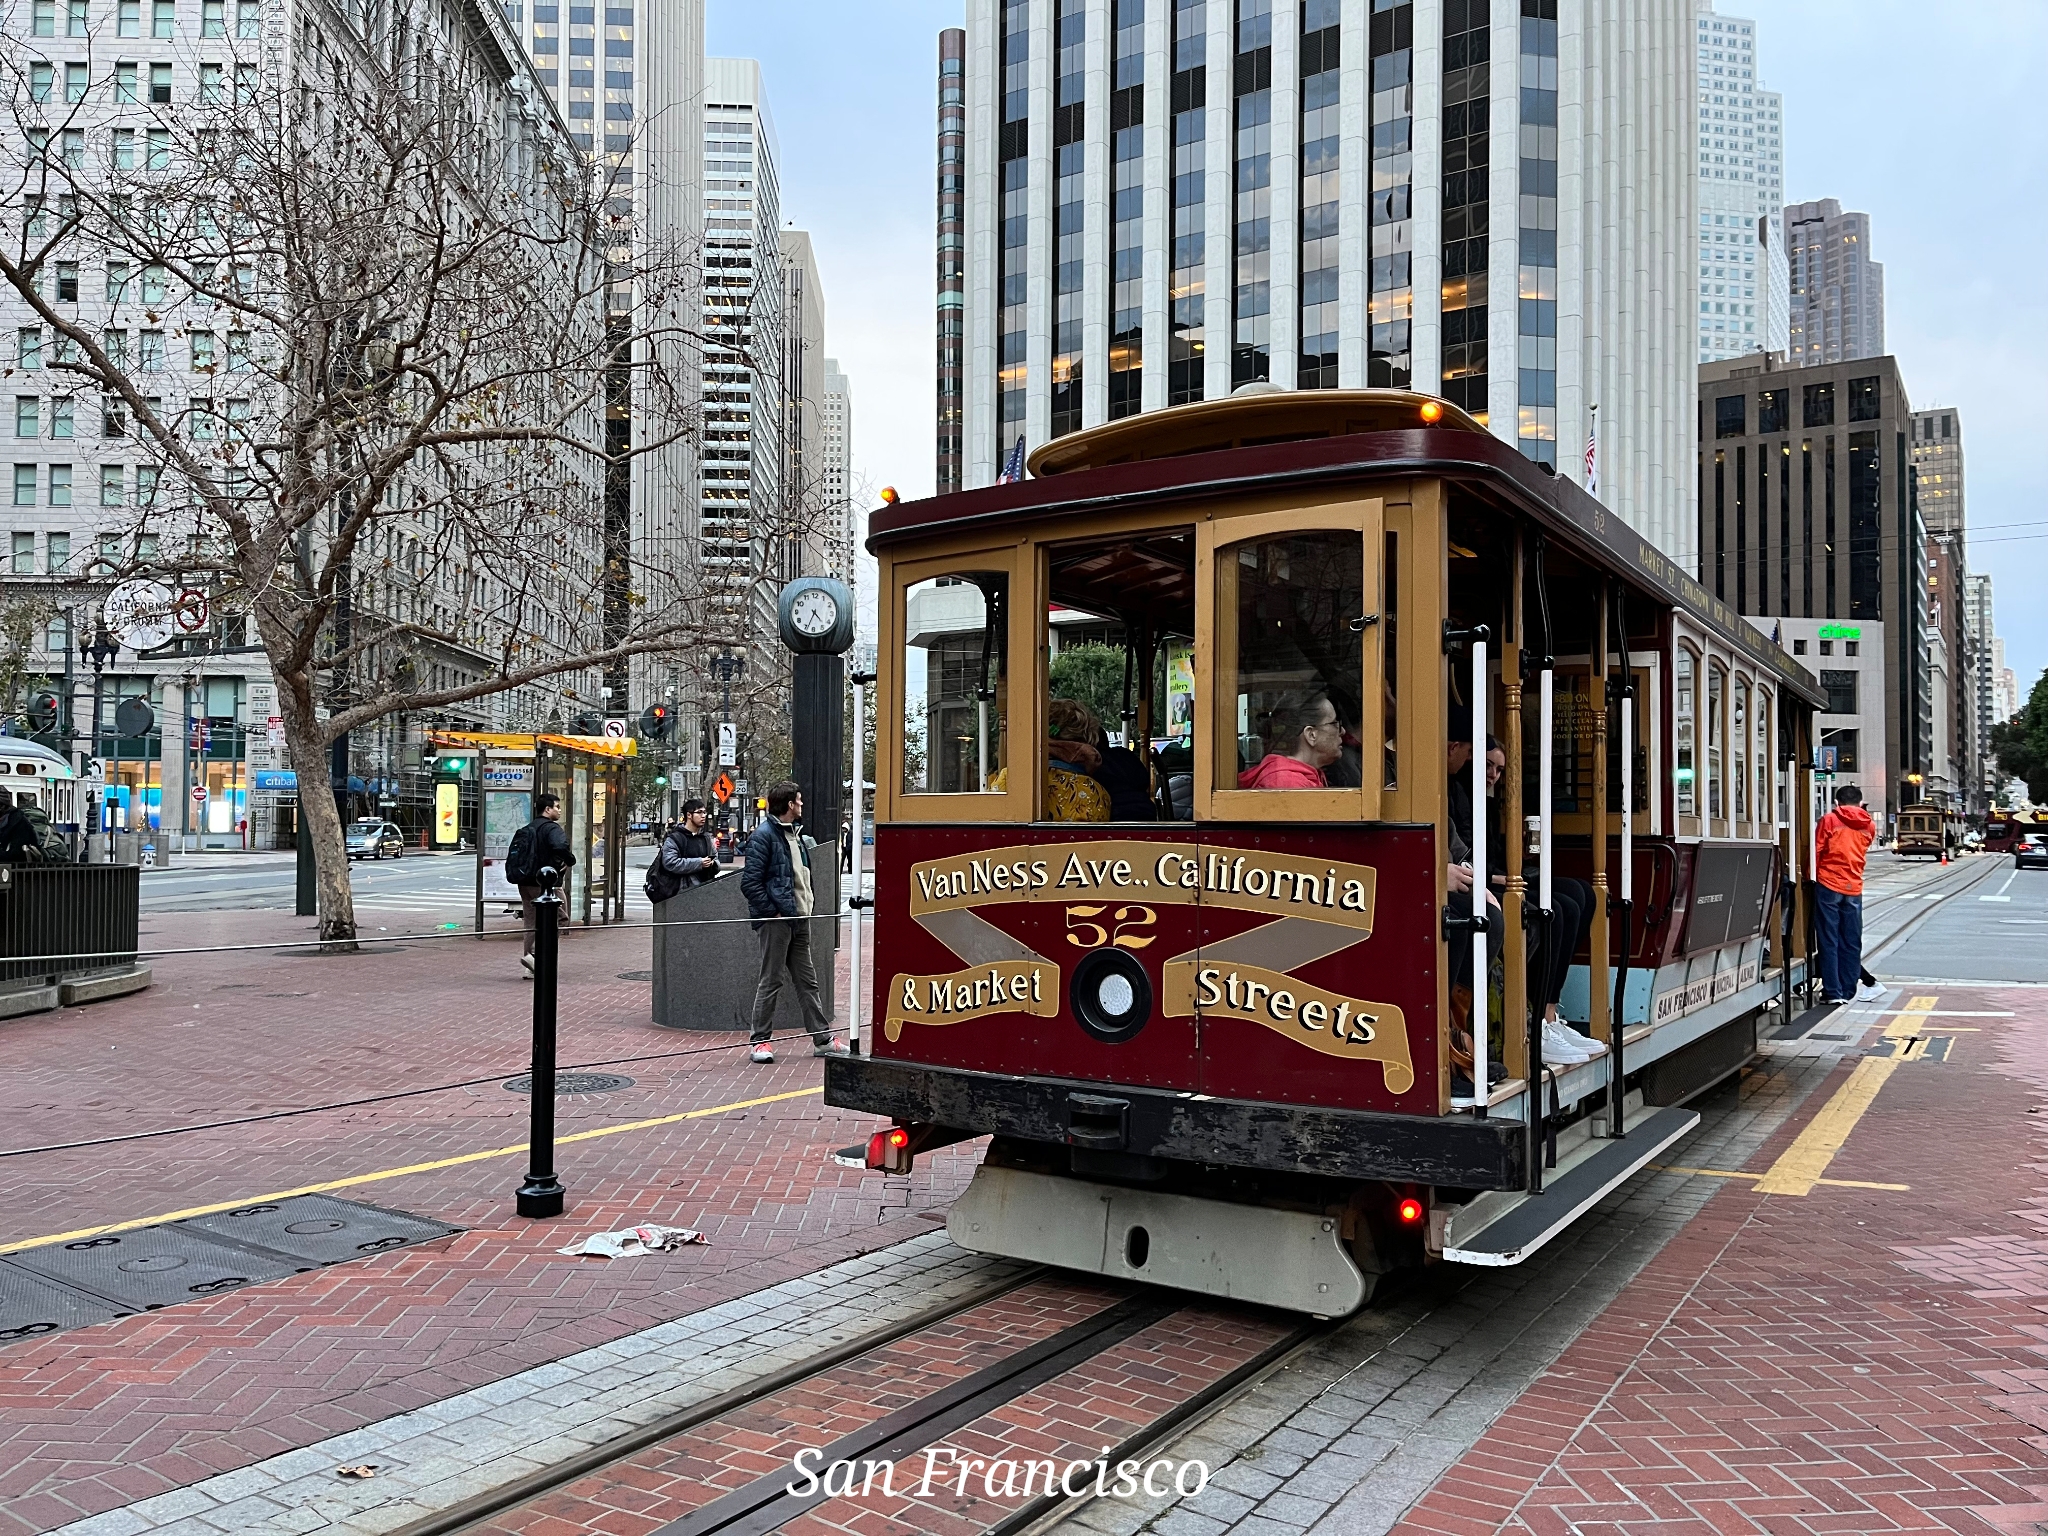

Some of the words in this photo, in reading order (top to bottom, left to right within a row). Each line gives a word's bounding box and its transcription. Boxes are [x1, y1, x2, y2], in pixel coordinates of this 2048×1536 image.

[1594, 509, 1605, 535] 52
[1639, 543, 1664, 579] MARKET
[1680, 577, 1709, 614] CHINATOWN
[1818, 623, 1861, 639] chime
[265, 776, 298, 786] citiban
[1154, 852, 1367, 913] California
[1066, 905, 1157, 949] 52
[902, 978, 923, 1011] &
[926, 968, 1043, 1014] Market
[1194, 968, 1380, 1045] Streets
[1657, 995, 1673, 1020] SAN
[1673, 983, 1708, 1013] FRANCISCO
[1709, 974, 1735, 999] MUNICIPAL
